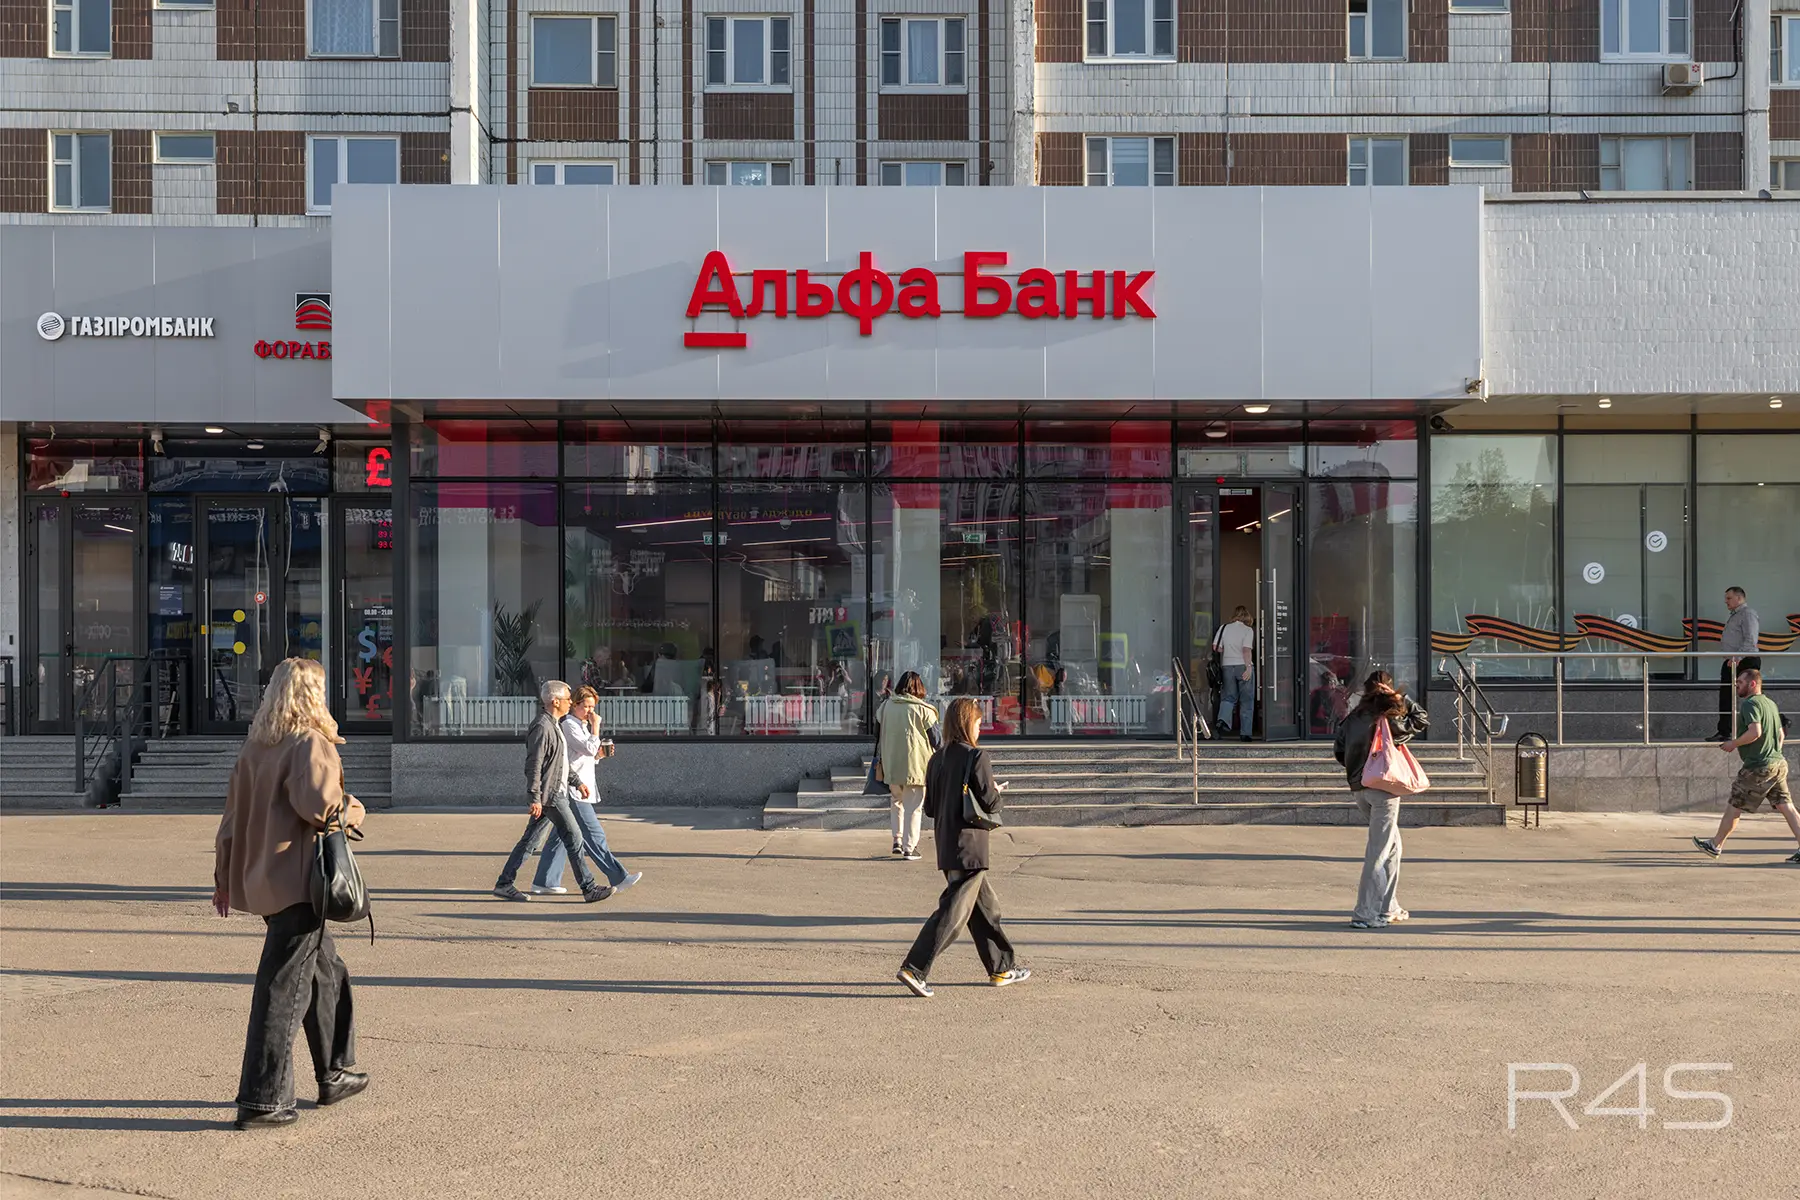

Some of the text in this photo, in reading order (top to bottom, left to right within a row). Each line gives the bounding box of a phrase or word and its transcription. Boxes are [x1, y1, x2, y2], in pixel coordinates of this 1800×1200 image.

[685, 250, 1157, 336] Альфа Банк
[71, 316, 215, 337] ГАЗПРОМБАНК
[253, 339, 332, 360] ФОРАБ
[365, 447, 392, 487] £
[358, 625, 378, 663] $
[352, 666, 374, 695] ¥
[365, 694, 383, 719] £
